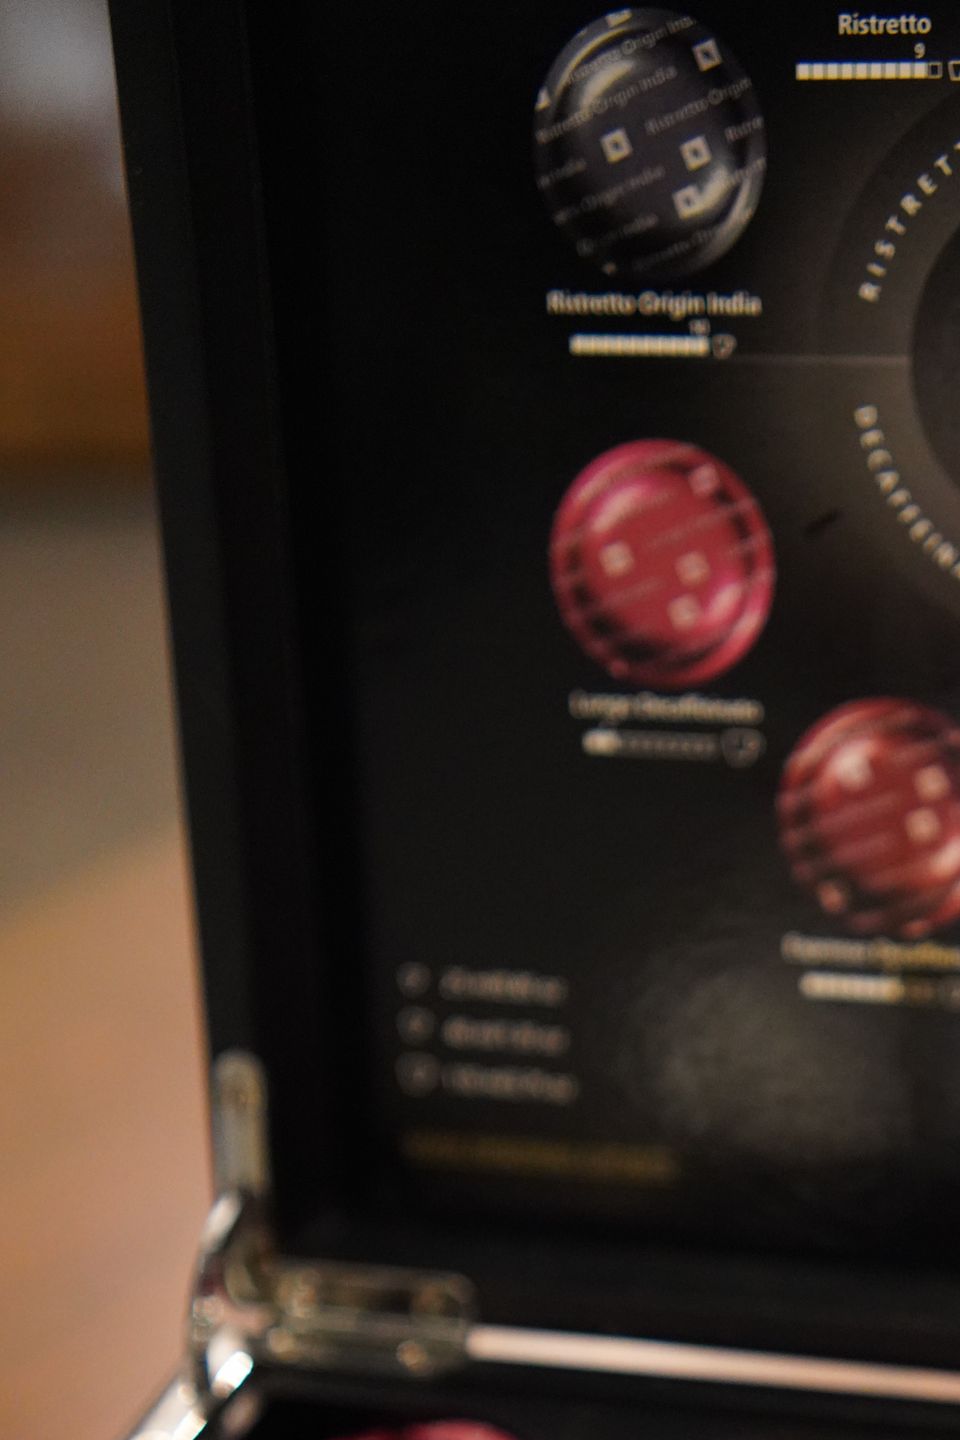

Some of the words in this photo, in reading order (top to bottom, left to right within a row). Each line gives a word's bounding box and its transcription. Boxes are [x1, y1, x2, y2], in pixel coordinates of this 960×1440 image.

[838, 13, 932, 36] Ristretto
[913, 43, 926, 59] 9
[546, 290, 635, 316] Ristretto
[637, 290, 706, 322] Origin
[706, 290, 762, 316] India
